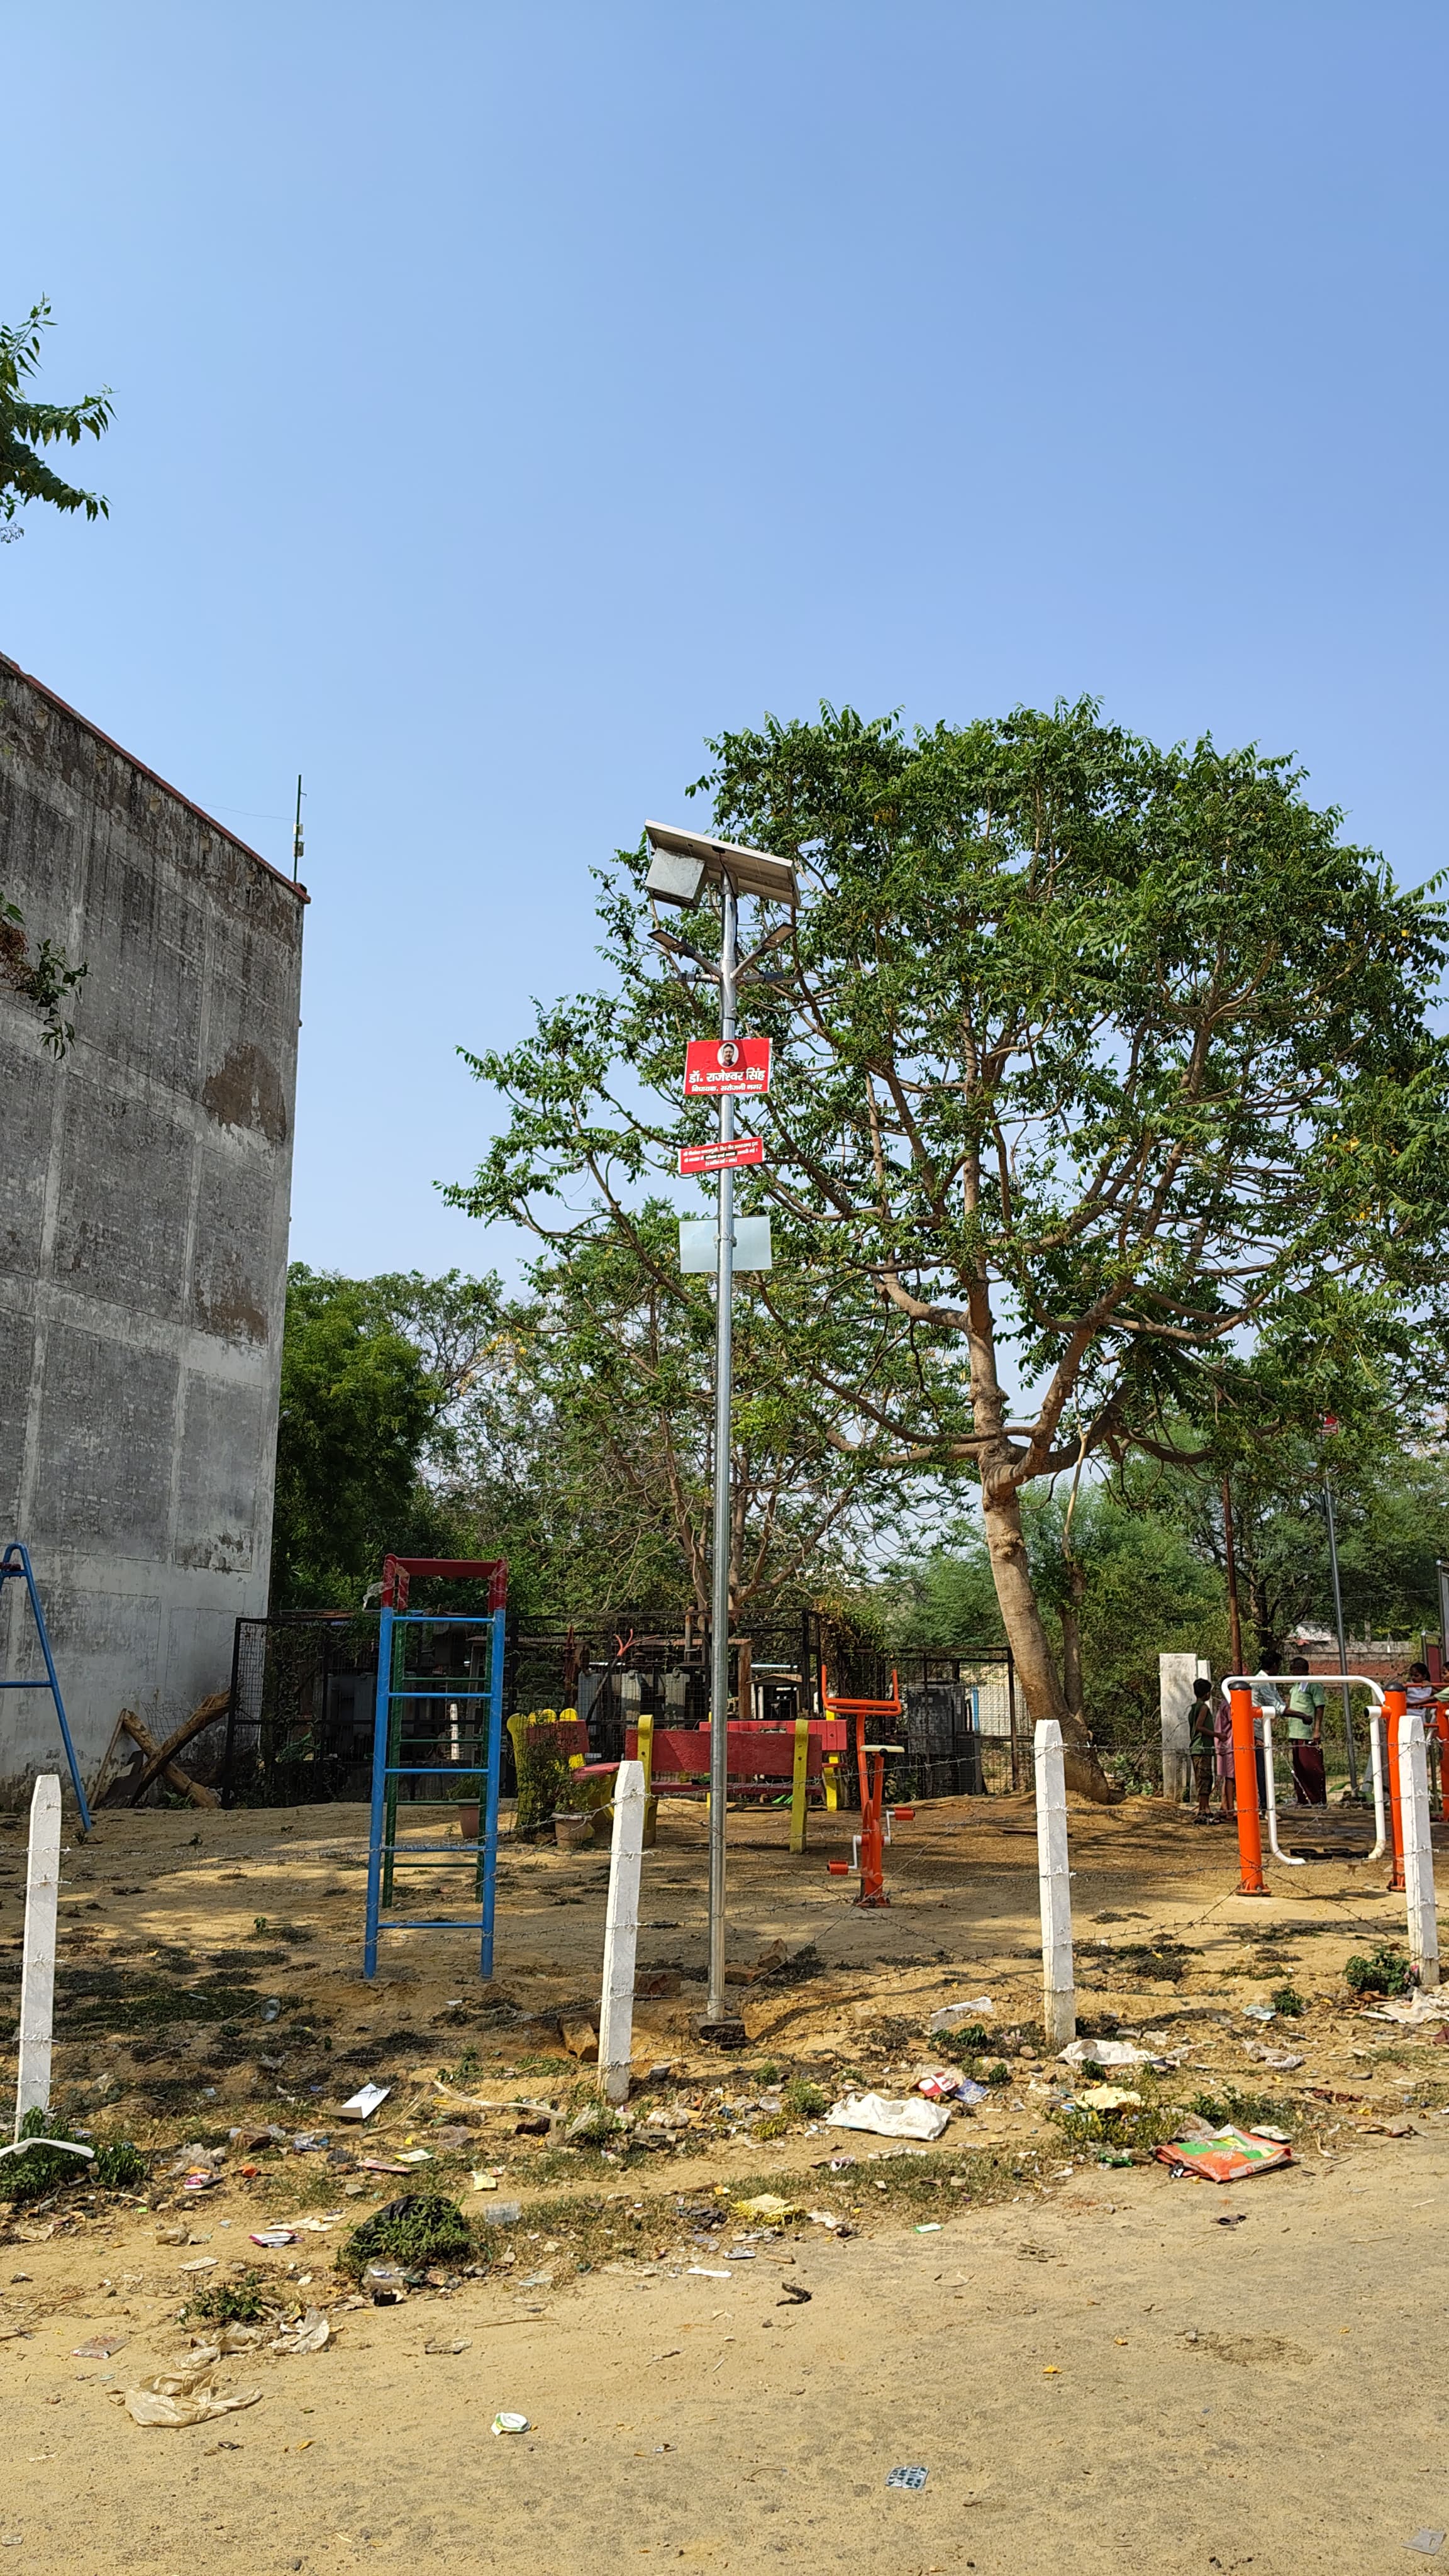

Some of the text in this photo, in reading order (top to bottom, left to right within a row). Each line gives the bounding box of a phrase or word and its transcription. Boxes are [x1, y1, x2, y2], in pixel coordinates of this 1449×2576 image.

[689, 1068, 765, 1082] डॉ. राजेश्वर सिंह
